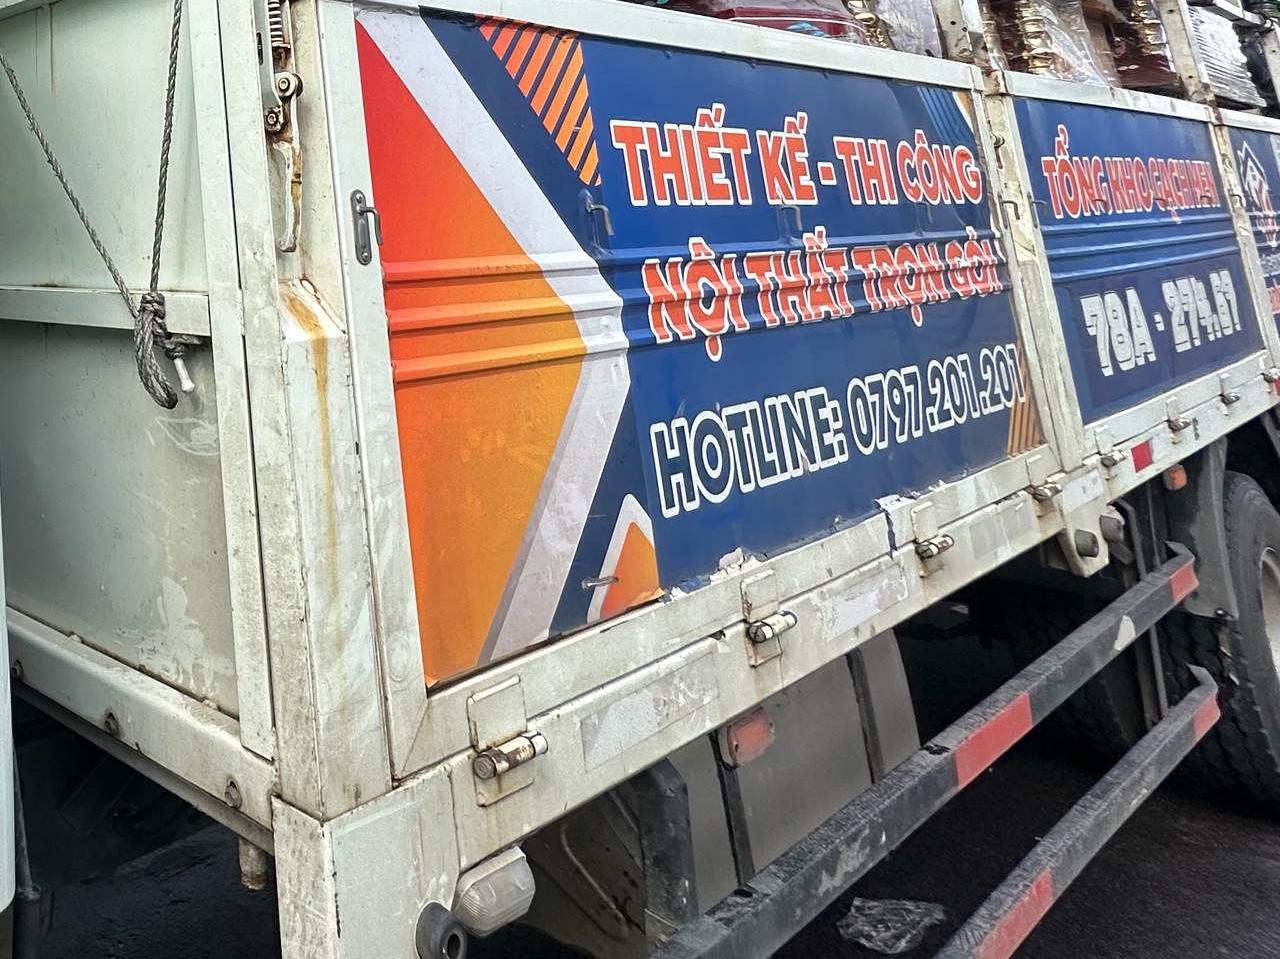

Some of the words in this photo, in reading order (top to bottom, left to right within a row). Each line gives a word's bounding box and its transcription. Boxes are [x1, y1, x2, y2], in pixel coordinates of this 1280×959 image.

[609, 103, 753, 206] THIẾT
[756, 111, 818, 206] KẾ
[818, 161, 837, 185] -
[833, 135, 898, 205] THI
[896, 129, 983, 205] CÔNG
[1041, 124, 1112, 219] TỔNG
[1105, 157, 1153, 214] KHO
[641, 237, 750, 362] NỘI
[744, 226, 854, 325] THẤT
[851, 241, 950, 327] TRỌN
[1080, 286, 1157, 377] 78A
[650, 386, 850, 518] HOTLINE:
[847, 343, 1026, 454] 0797.201.201
